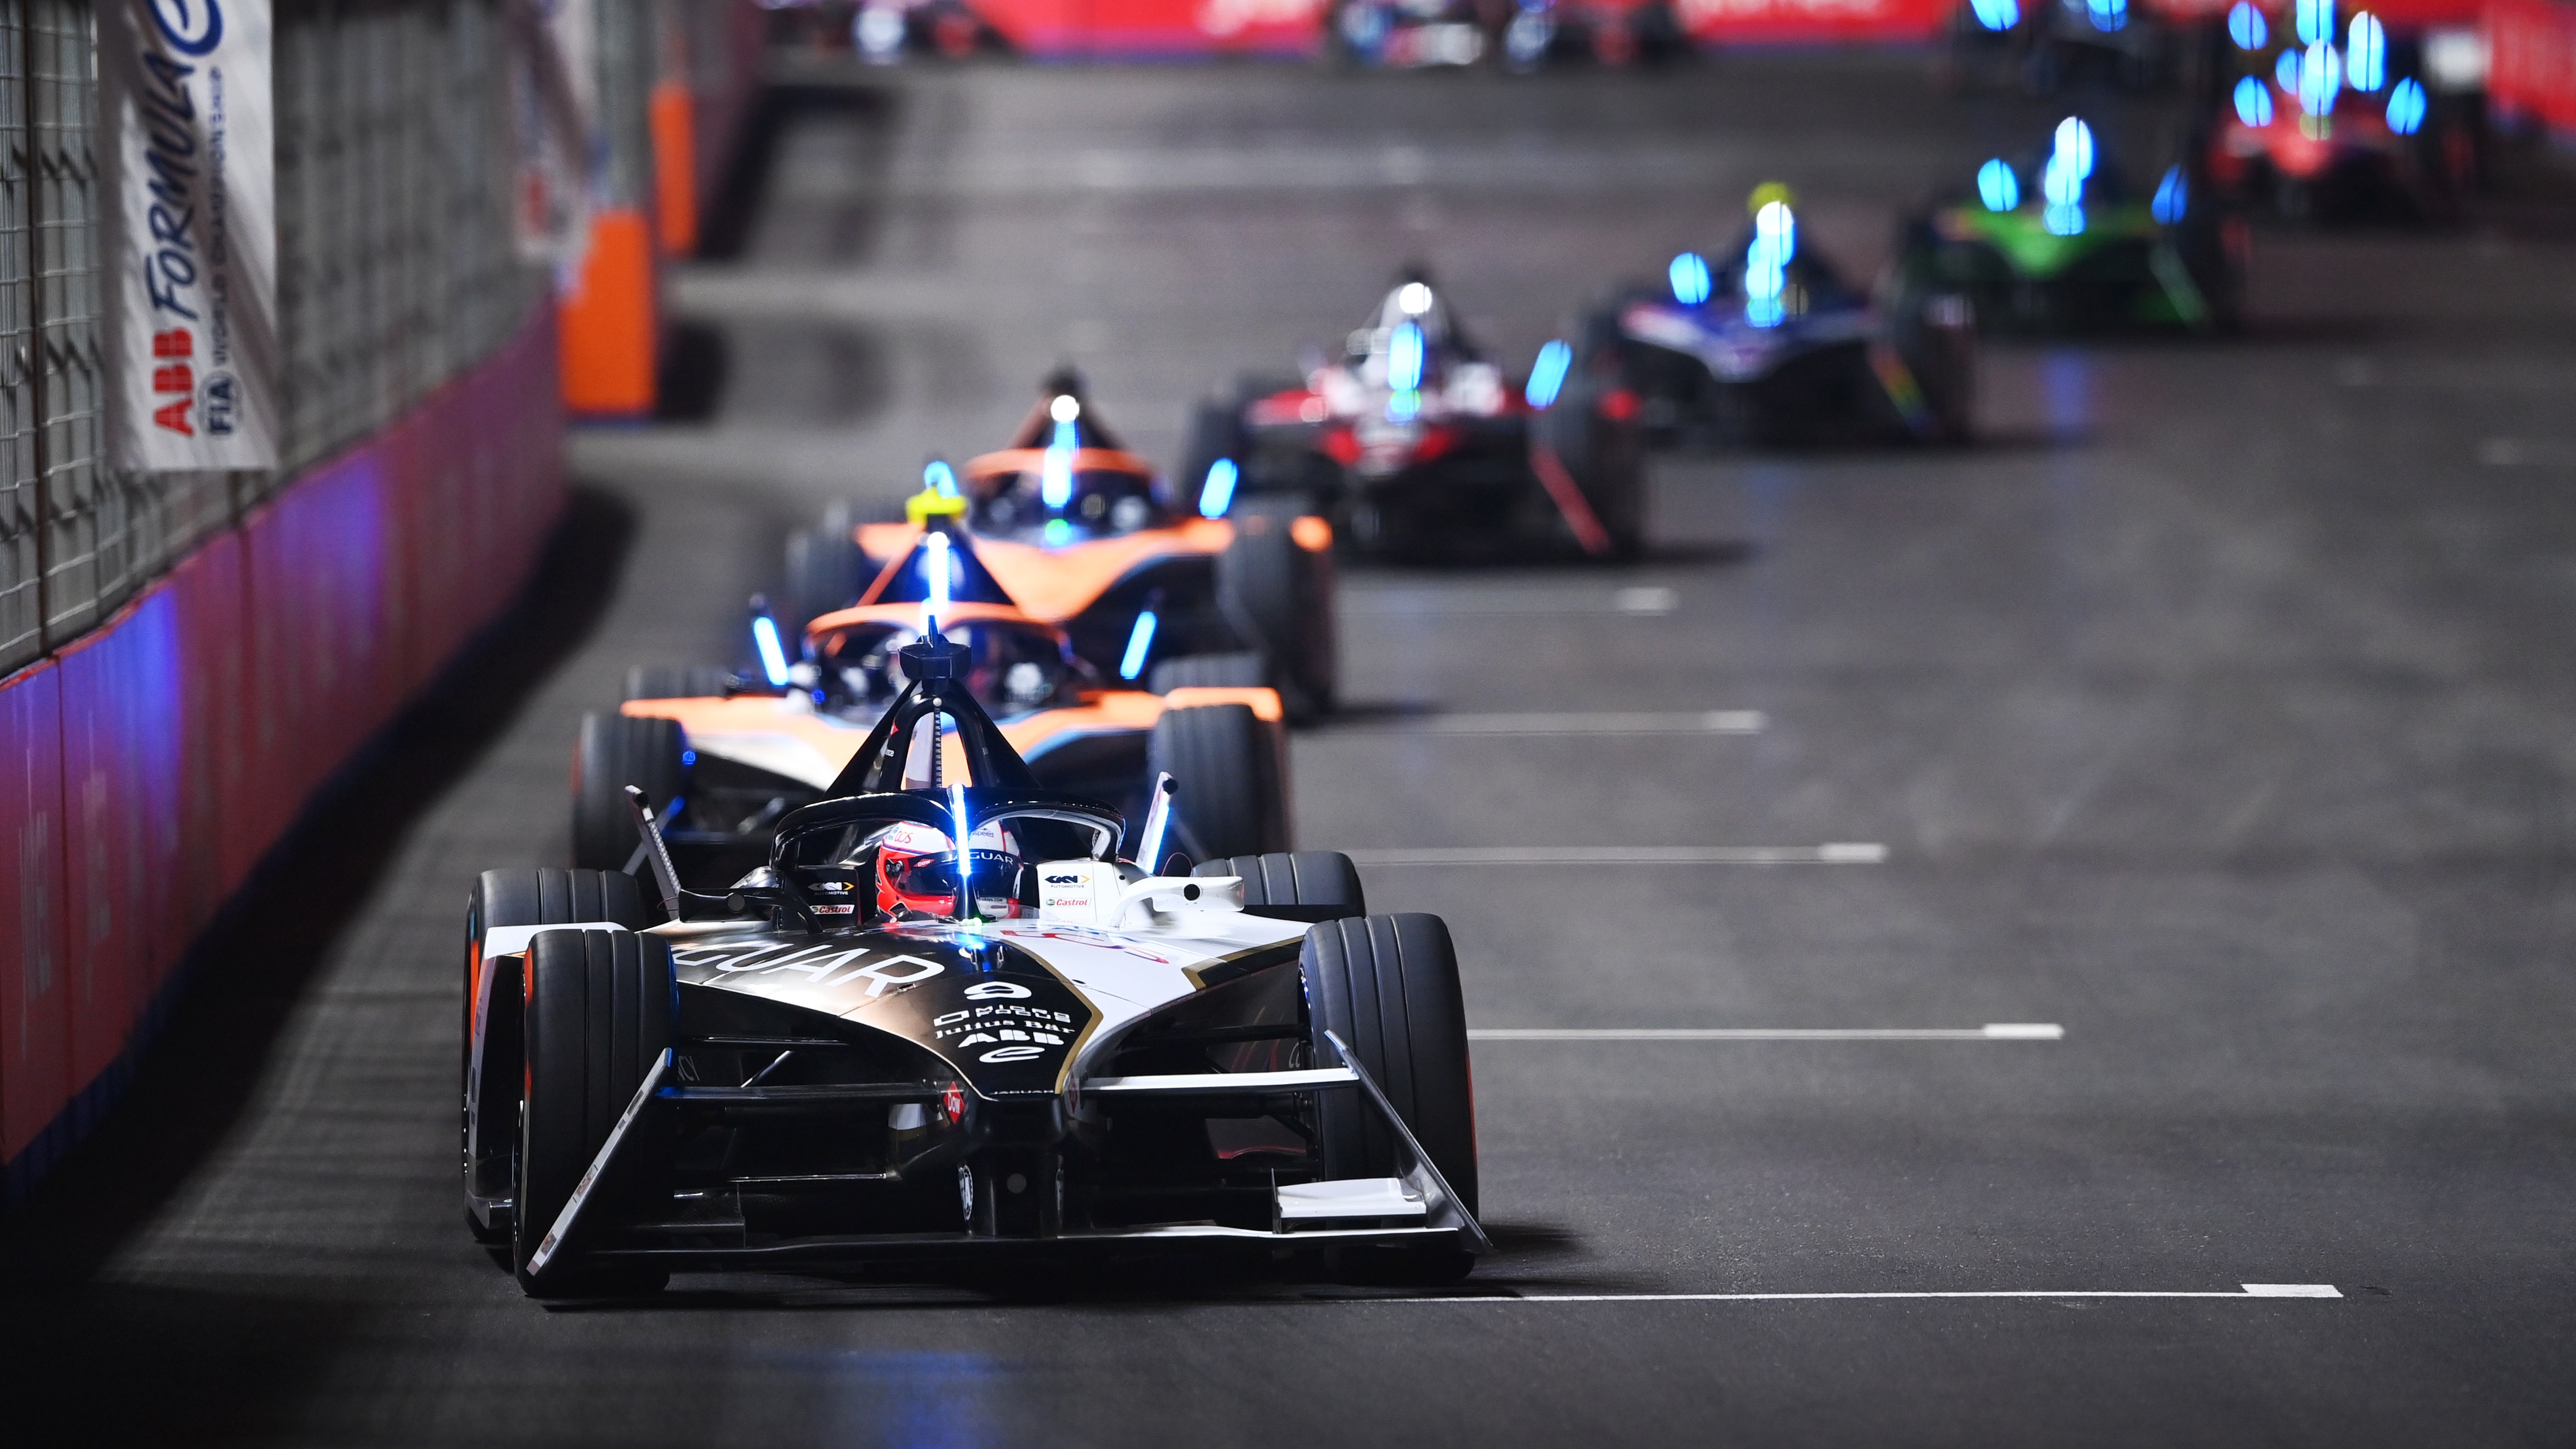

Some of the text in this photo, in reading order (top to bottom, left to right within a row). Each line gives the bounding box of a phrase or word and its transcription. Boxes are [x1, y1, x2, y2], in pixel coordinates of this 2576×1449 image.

[144, 50, 199, 321] FORMULA
[153, 327, 194, 437] ABB
[207, 377, 233, 435] FIA
[671, 940, 945, 998] GUAR
[964, 981, 1032, 1000] 9
[934, 1020, 1015, 1039] Julius
[958, 1029, 1064, 1048] ABB
